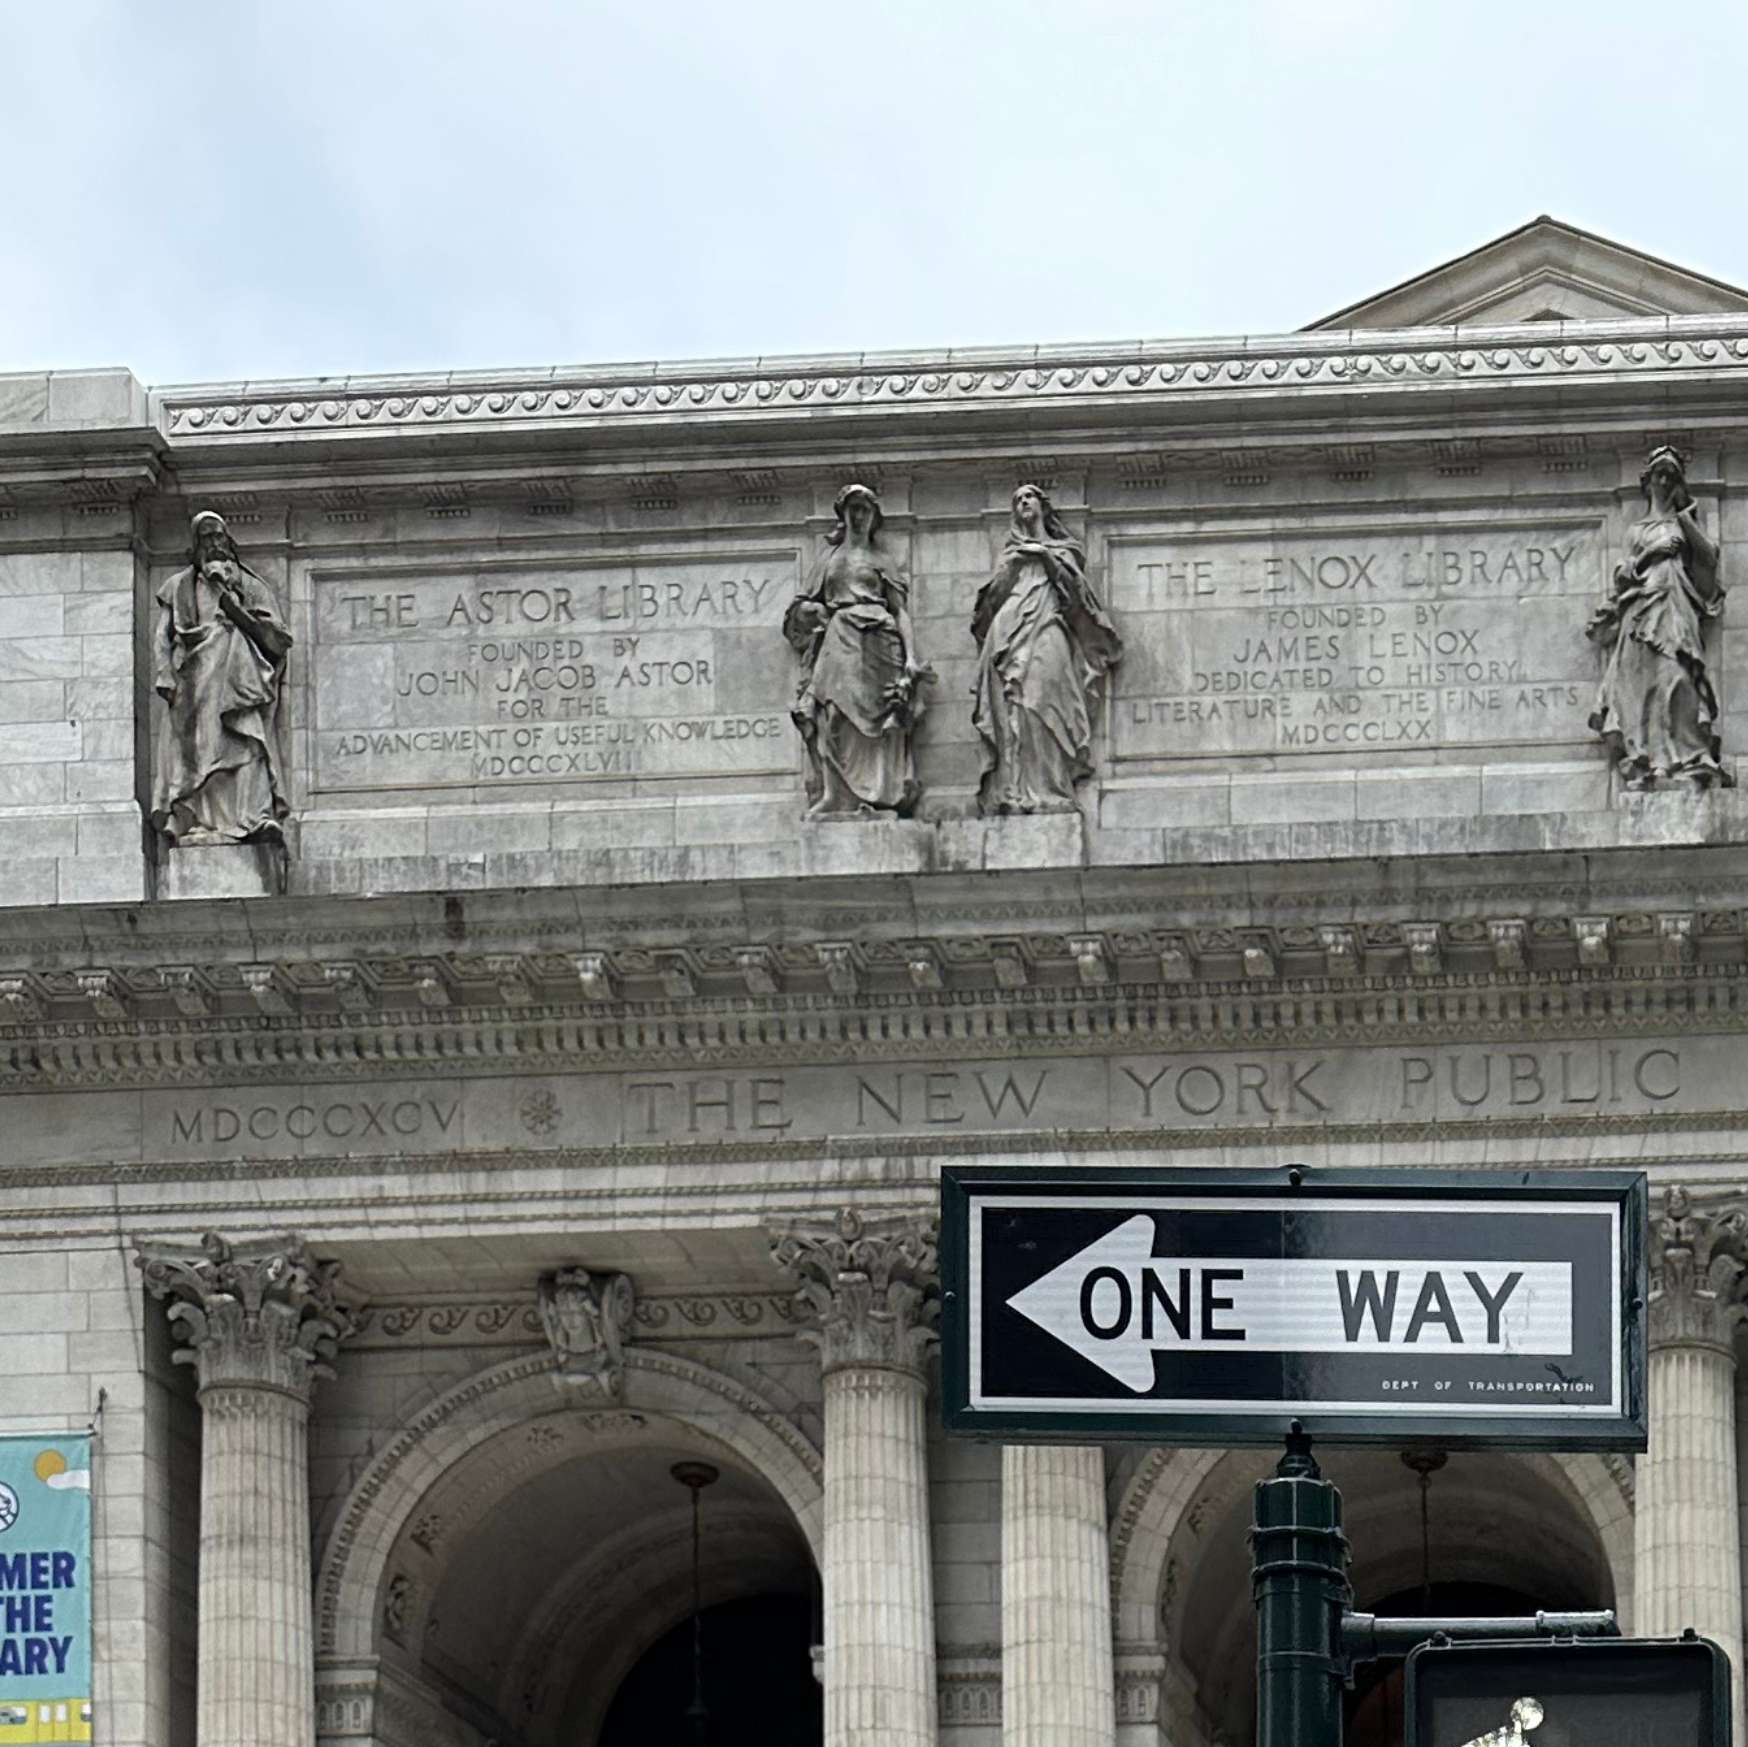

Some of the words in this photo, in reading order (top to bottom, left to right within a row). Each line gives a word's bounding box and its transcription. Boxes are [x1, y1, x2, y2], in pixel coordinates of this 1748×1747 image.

[1137, 560, 1218, 599] THE
[1239, 553, 1378, 595] LENOX
[1402, 546, 1577, 589] LIBRARY
[342, 594, 419, 630] THE
[447, 588, 576, 626] ASTOR
[598, 579, 771, 620] LIBRARY
[1268, 607, 1387, 631] FOUNDED
[1416, 604, 1445, 625] BY
[468, 639, 583, 664] FOUNDED
[613, 636, 640, 657] BY
[1233, 636, 1340, 665] JAMES
[1370, 629, 1480, 659] LENOX
[397, 670, 480, 697] JOHN
[496, 665, 597, 693] JACOB
[615, 660, 713, 688] ASTOR
[1195, 668, 1334, 693] DEDICATED
[1349, 665, 1384, 686] TO
[1407, 661, 1519, 685] HISTORY
[497, 699, 545, 719] FOR
[560, 696, 609, 717] THE
[1132, 697, 1292, 725] LITERATURE
[1313, 694, 1362, 716] AND
[1382, 692, 1430, 714] THE
[1446, 689, 1501, 711] FINE
[1516, 686, 1580, 708] ARTS
[336, 729, 506, 757] ADVANCEMENT
[513, 727, 544, 747] OF
[554, 723, 636, 746] USEFUL
[643, 717, 781, 742] KNOWLEDGE
[1282, 718, 1432, 746] MDCCCLXX
[171, 1100, 460, 1145] MDCCCXCV
[627, 1078, 793, 1135] THE
[855, 1068, 1051, 1127] NEW
[1119, 1058, 1331, 1117] YORK
[1400, 1047, 1682, 1109] PUBLIC
[1079, 1265, 1247, 1341] ONE
[1336, 1270, 1524, 1344] WAY
[1382, 1380, 1418, 1391] DEPT
[1434, 1380, 1453, 1391] OF
[1468, 1380, 1595, 1393] TRANSPORTATION
